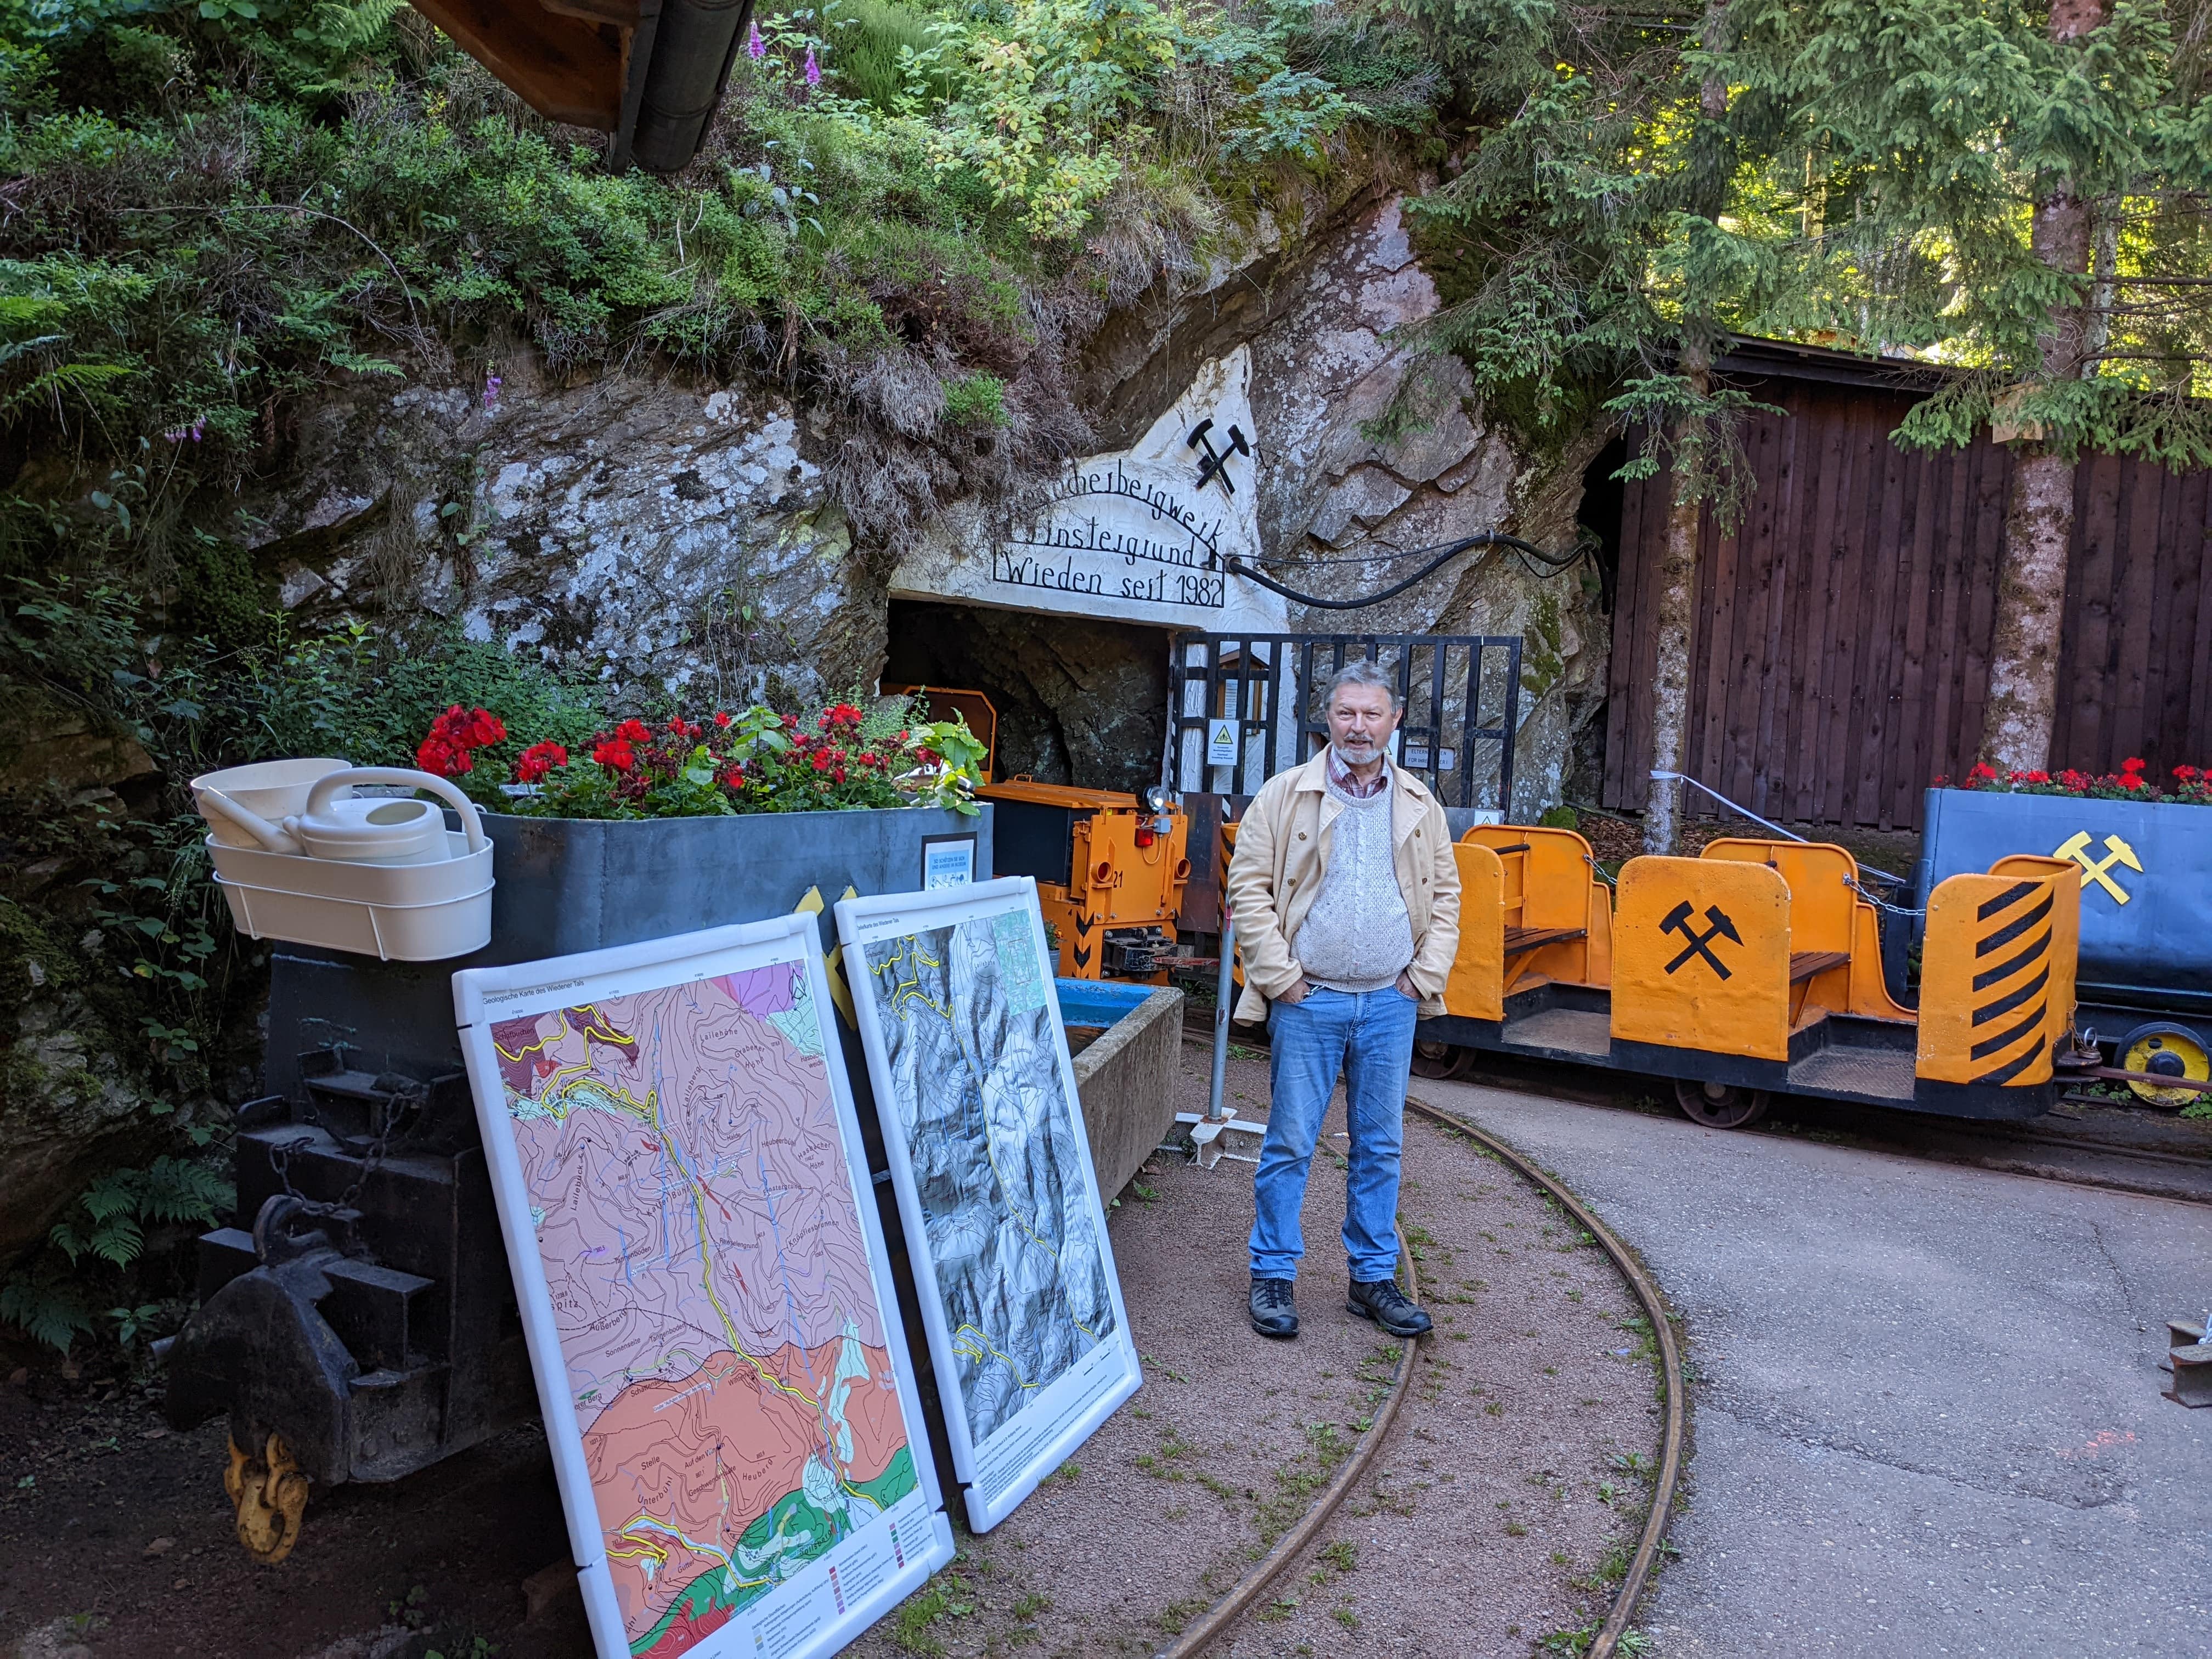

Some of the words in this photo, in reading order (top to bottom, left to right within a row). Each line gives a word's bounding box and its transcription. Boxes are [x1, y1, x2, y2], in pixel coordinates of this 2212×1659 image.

[1000, 550, 1102, 595] Wieden
[1120, 569, 1167, 601] seit
[1176, 575, 1222, 606] 1982
[1113, 870, 1123, 888] 21
[483, 992, 518, 1005] Geologische
[520, 989, 534, 998] Karte
[546, 982, 572, 992] Wiedener
[573, 980, 585, 988] Tals
[494, 1026, 535, 1041] Schafbuchen
[727, 1132, 741, 1141] Halde
[761, 1138, 796, 1148] Heubeerbühl
[605, 1338, 641, 1358] Sonnenseite
[588, 1393, 602, 1403] Berg
[641, 1455, 660, 1471] Stelle
[695, 1454, 706, 1463] den
[742, 1458, 773, 1481] Heuberg
[637, 1476, 673, 1505] Unterbühl
